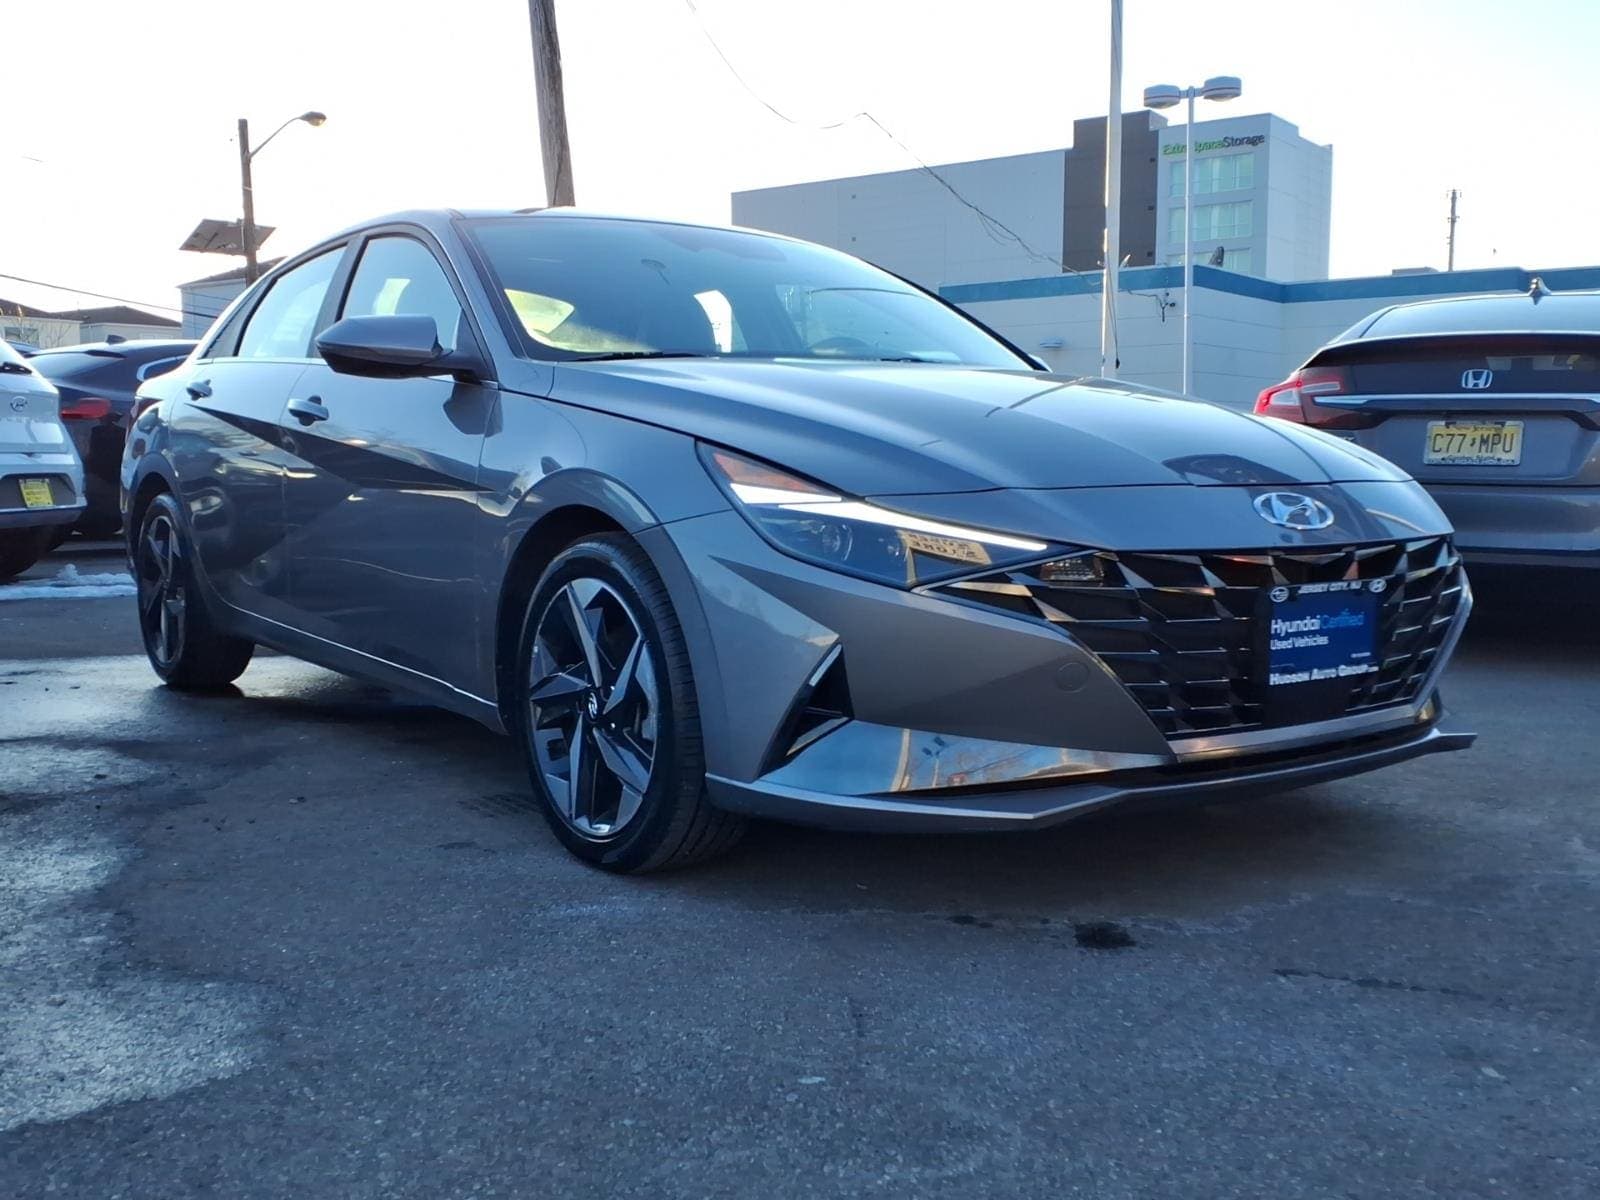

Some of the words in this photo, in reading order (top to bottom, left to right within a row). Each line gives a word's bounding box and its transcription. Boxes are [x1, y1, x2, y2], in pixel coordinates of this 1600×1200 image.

[1432, 433, 1467, 453] C77
[1478, 433, 1514, 453] MPU
[1270, 615, 1321, 636] Hyundai
[1270, 637, 1293, 650] Used
[1292, 634, 1329, 648] Vehicles
